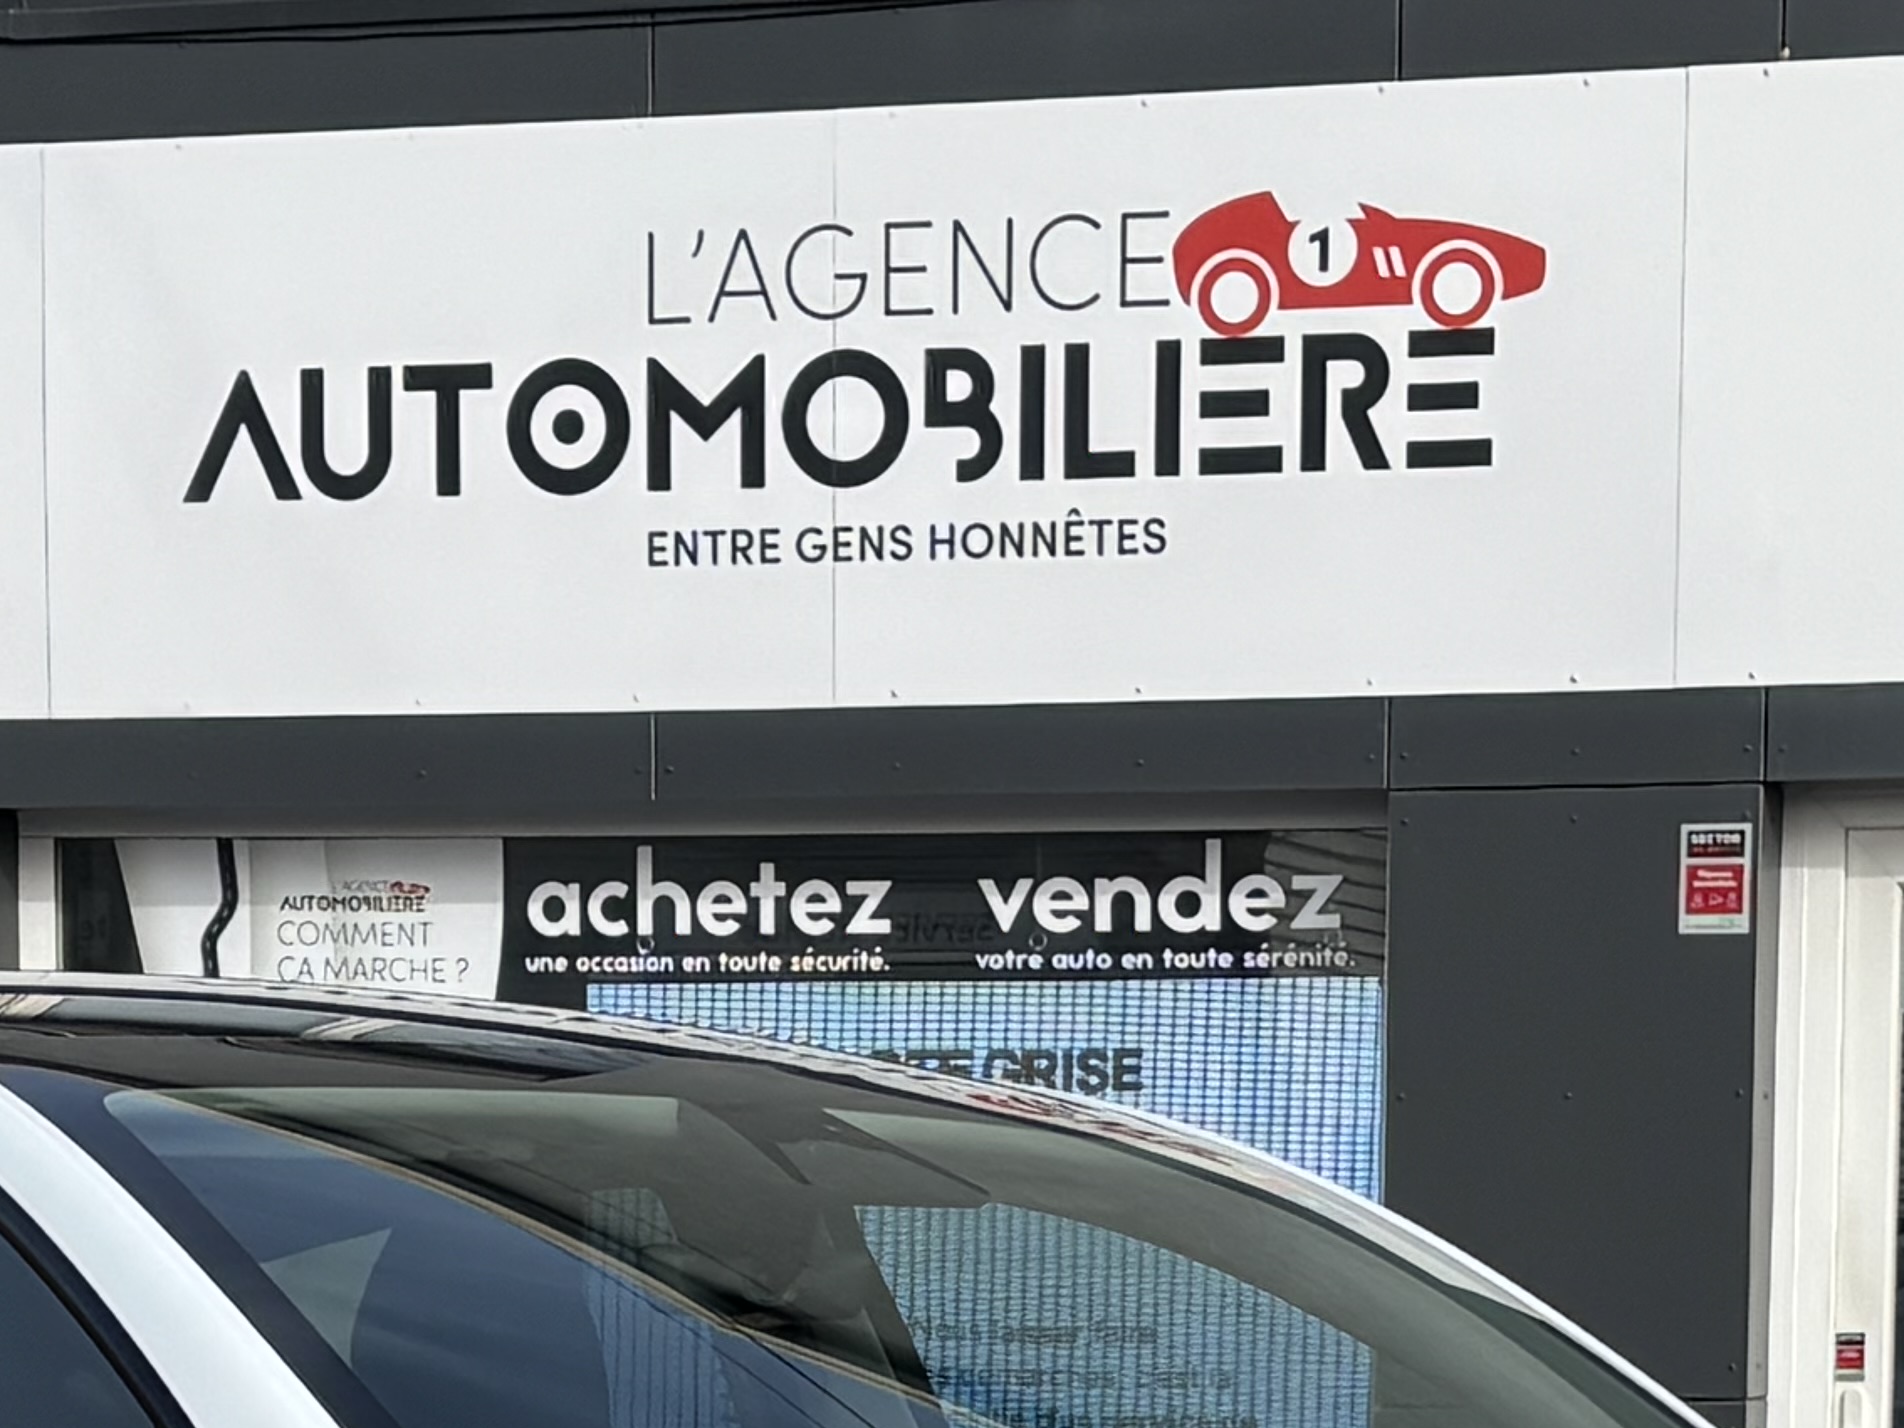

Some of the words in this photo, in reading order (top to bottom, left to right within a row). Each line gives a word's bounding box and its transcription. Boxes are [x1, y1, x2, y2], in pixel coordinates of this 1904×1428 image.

[647, 210, 1171, 326] L'AGENCE
[647, 527, 782, 567] ENTRE
[795, 524, 913, 564] GENS
[929, 507, 1167, 561] HONNÊTES
[526, 846, 892, 937] achetez
[978, 839, 1343, 934] vendez
[277, 920, 433, 948] COMMENT
[974, 946, 1046, 972] votre
[1051, 946, 1113, 971] auto
[1120, 949, 1156, 971] en
[1162, 945, 1237, 971] toute
[1241, 939, 1360, 971] sérénité.
[323, 956, 446, 984] MARCHE
[455, 956, 470, 984] ?
[524, 952, 569, 974] une
[575, 948, 676, 974] occasion
[680, 952, 713, 974] en
[717, 948, 786, 974] toute
[789, 943, 894, 974] sécurité.
